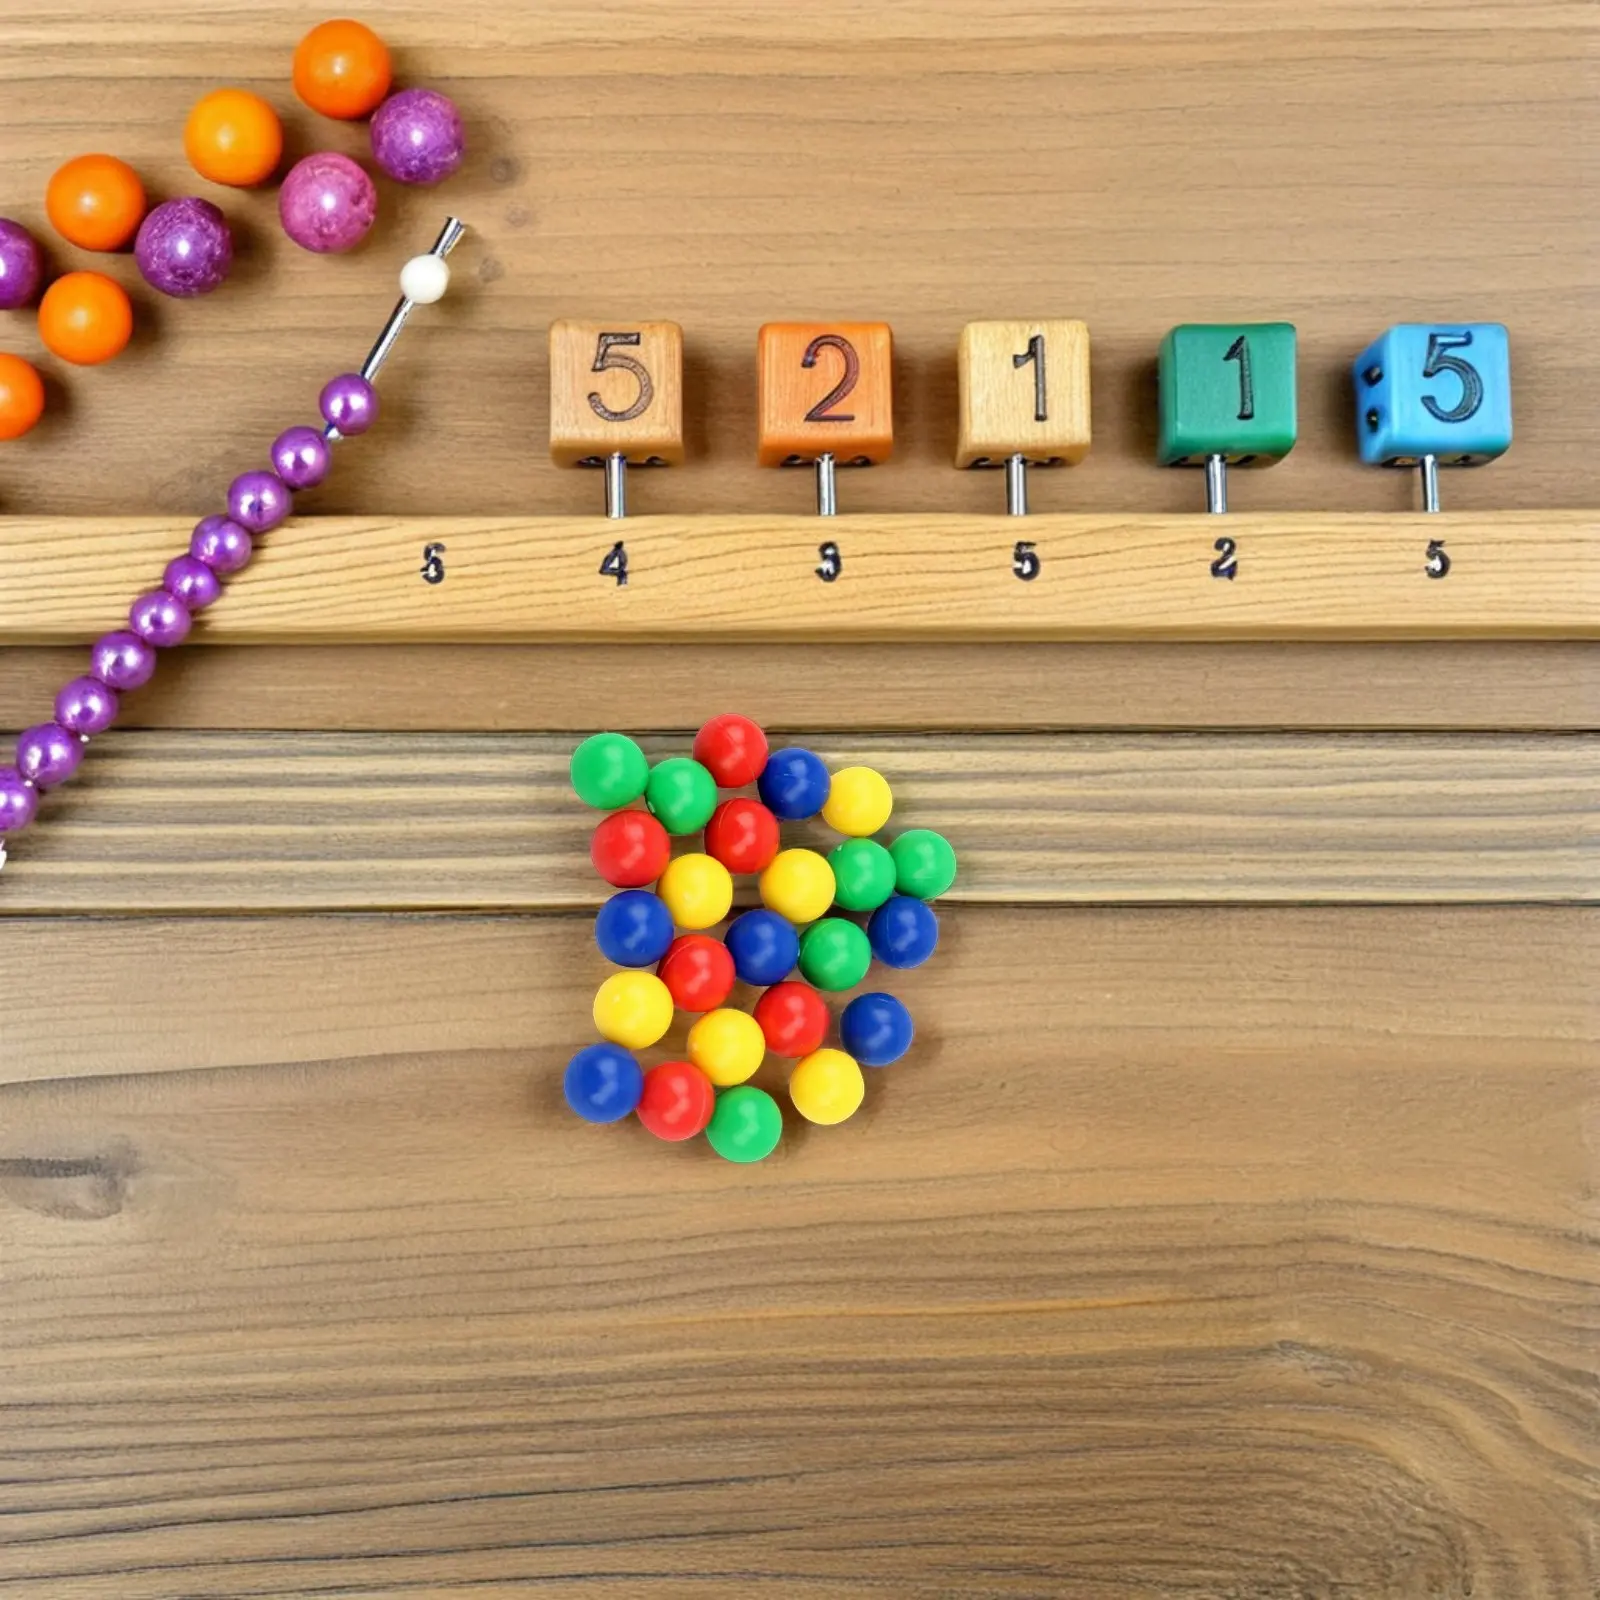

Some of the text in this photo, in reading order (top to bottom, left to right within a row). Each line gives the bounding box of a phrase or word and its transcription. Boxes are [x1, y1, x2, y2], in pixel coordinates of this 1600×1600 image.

[588, 332, 653, 421] 5
[801, 333, 859, 422] 2
[1012, 334, 1048, 422] 1
[1222, 334, 1254, 420] 1
[1420, 330, 1484, 424] 5
[599, 541, 628, 586] 4
[1012, 541, 1040, 582] 5
[1211, 537, 1239, 581] 2
[1425, 540, 1450, 580] 5
